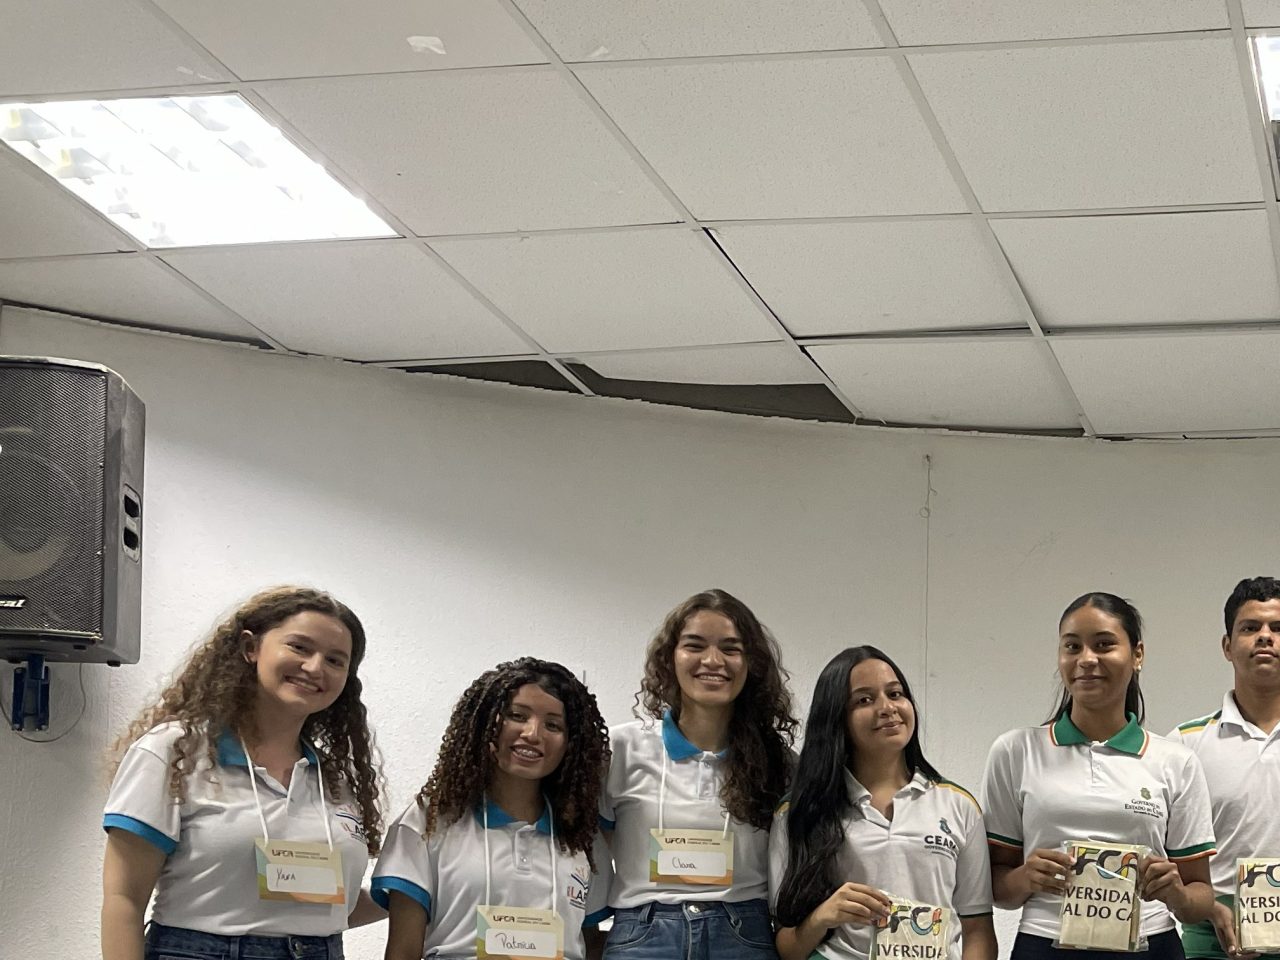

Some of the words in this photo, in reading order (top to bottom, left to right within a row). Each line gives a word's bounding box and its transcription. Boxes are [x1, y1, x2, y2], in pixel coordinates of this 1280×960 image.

[664, 837, 686, 845] UFCA
[1066, 886, 1131, 904] VERSIDA
[1063, 902, 1081, 916] AL
[1087, 905, 1111, 919] DO
[1241, 912, 1260, 924] AL
